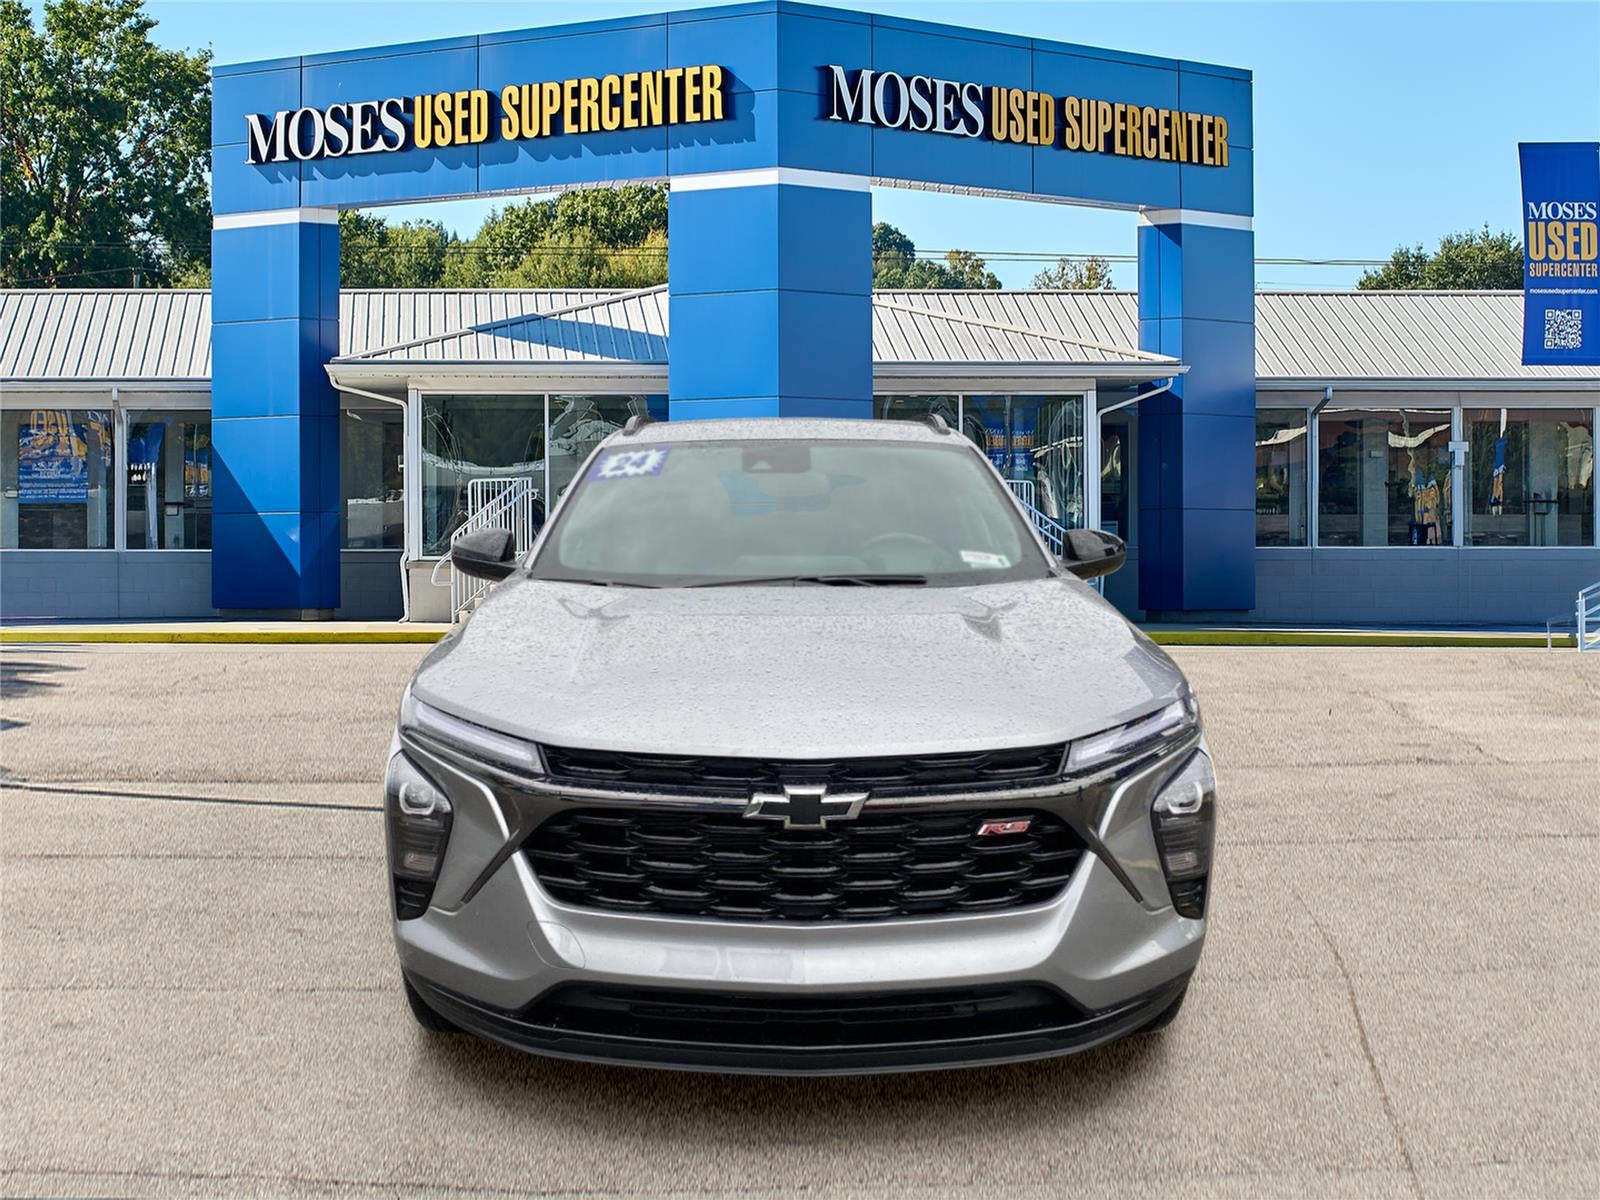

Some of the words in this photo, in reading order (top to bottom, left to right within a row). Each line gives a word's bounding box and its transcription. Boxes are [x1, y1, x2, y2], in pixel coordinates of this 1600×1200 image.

[244, 98, 406, 165] MOSES
[413, 89, 489, 149] USED
[500, 64, 724, 141] SUPERCENTER
[828, 64, 985, 138] MOSES
[991, 86, 1055, 146] USED
[1064, 95, 1229, 167] SUPERCENTER
[1528, 202, 1596, 219] MOSES
[1528, 221, 1598, 260] USED
[1529, 263, 1598, 277] SUPERCENTER
[977, 820, 1030, 835] RS
